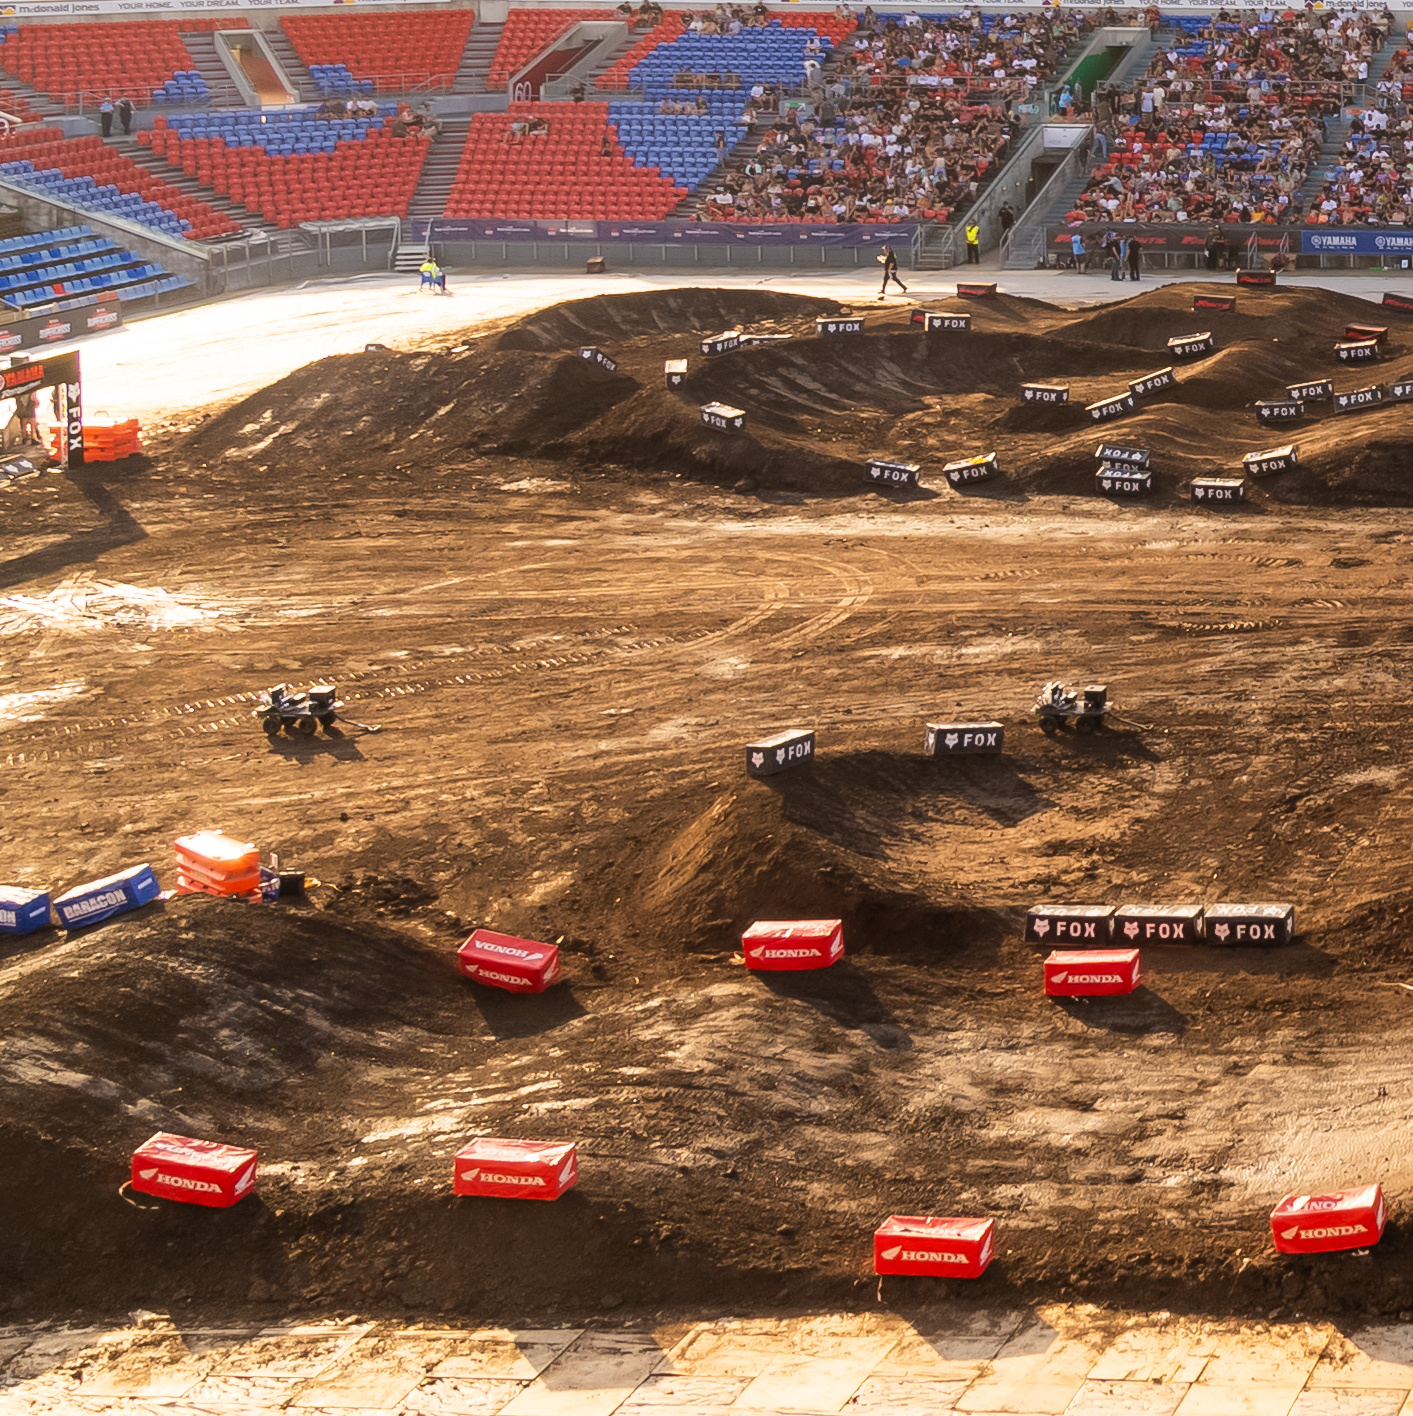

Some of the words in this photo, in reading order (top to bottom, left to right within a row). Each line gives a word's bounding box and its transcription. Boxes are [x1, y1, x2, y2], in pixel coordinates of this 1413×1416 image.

[71, 3, 99, 14] jones
[118, 2, 143, 10] YOUR
[180, 0, 205, 8] YOUR
[1322, 235, 1357, 246] YAMAHA
[839, 323, 860, 333] FOX
[944, 319, 966, 329] FOX
[1185, 342, 1206, 353] FOX
[1350, 347, 1371, 358] FOX
[1147, 376, 1169, 390] FOX
[1035, 391, 1056, 402] FOX
[1300, 386, 1323, 397] FOX
[1350, 392, 1372, 403] FOX
[1102, 402, 1123, 414] FOX
[1274, 406, 1296, 418] FOX
[68, 406, 83, 450] FOX
[1262, 459, 1287, 471] FOX
[884, 470, 909, 483] FOX
[963, 465, 988, 479] FOX
[1115, 481, 1139, 492] FOX
[1208, 488, 1232, 499] FOX
[963, 732, 997, 746] FOX
[788, 741, 811, 761] FOX
[64, 889, 128, 920] DARACON
[1057, 922, 1096, 938] FOX
[1146, 923, 1185, 939] FOX
[1237, 924, 1275, 939] FOX
[765, 949, 822, 959] HONDA
[478, 967, 533, 986] HONDA
[1068, 973, 1124, 984] HONDA
[157, 1172, 223, 1194] HONDA
[480, 1172, 547, 1187] HONDA
[1300, 1224, 1369, 1239] HONDA
[902, 1250, 969, 1263] HONDA
